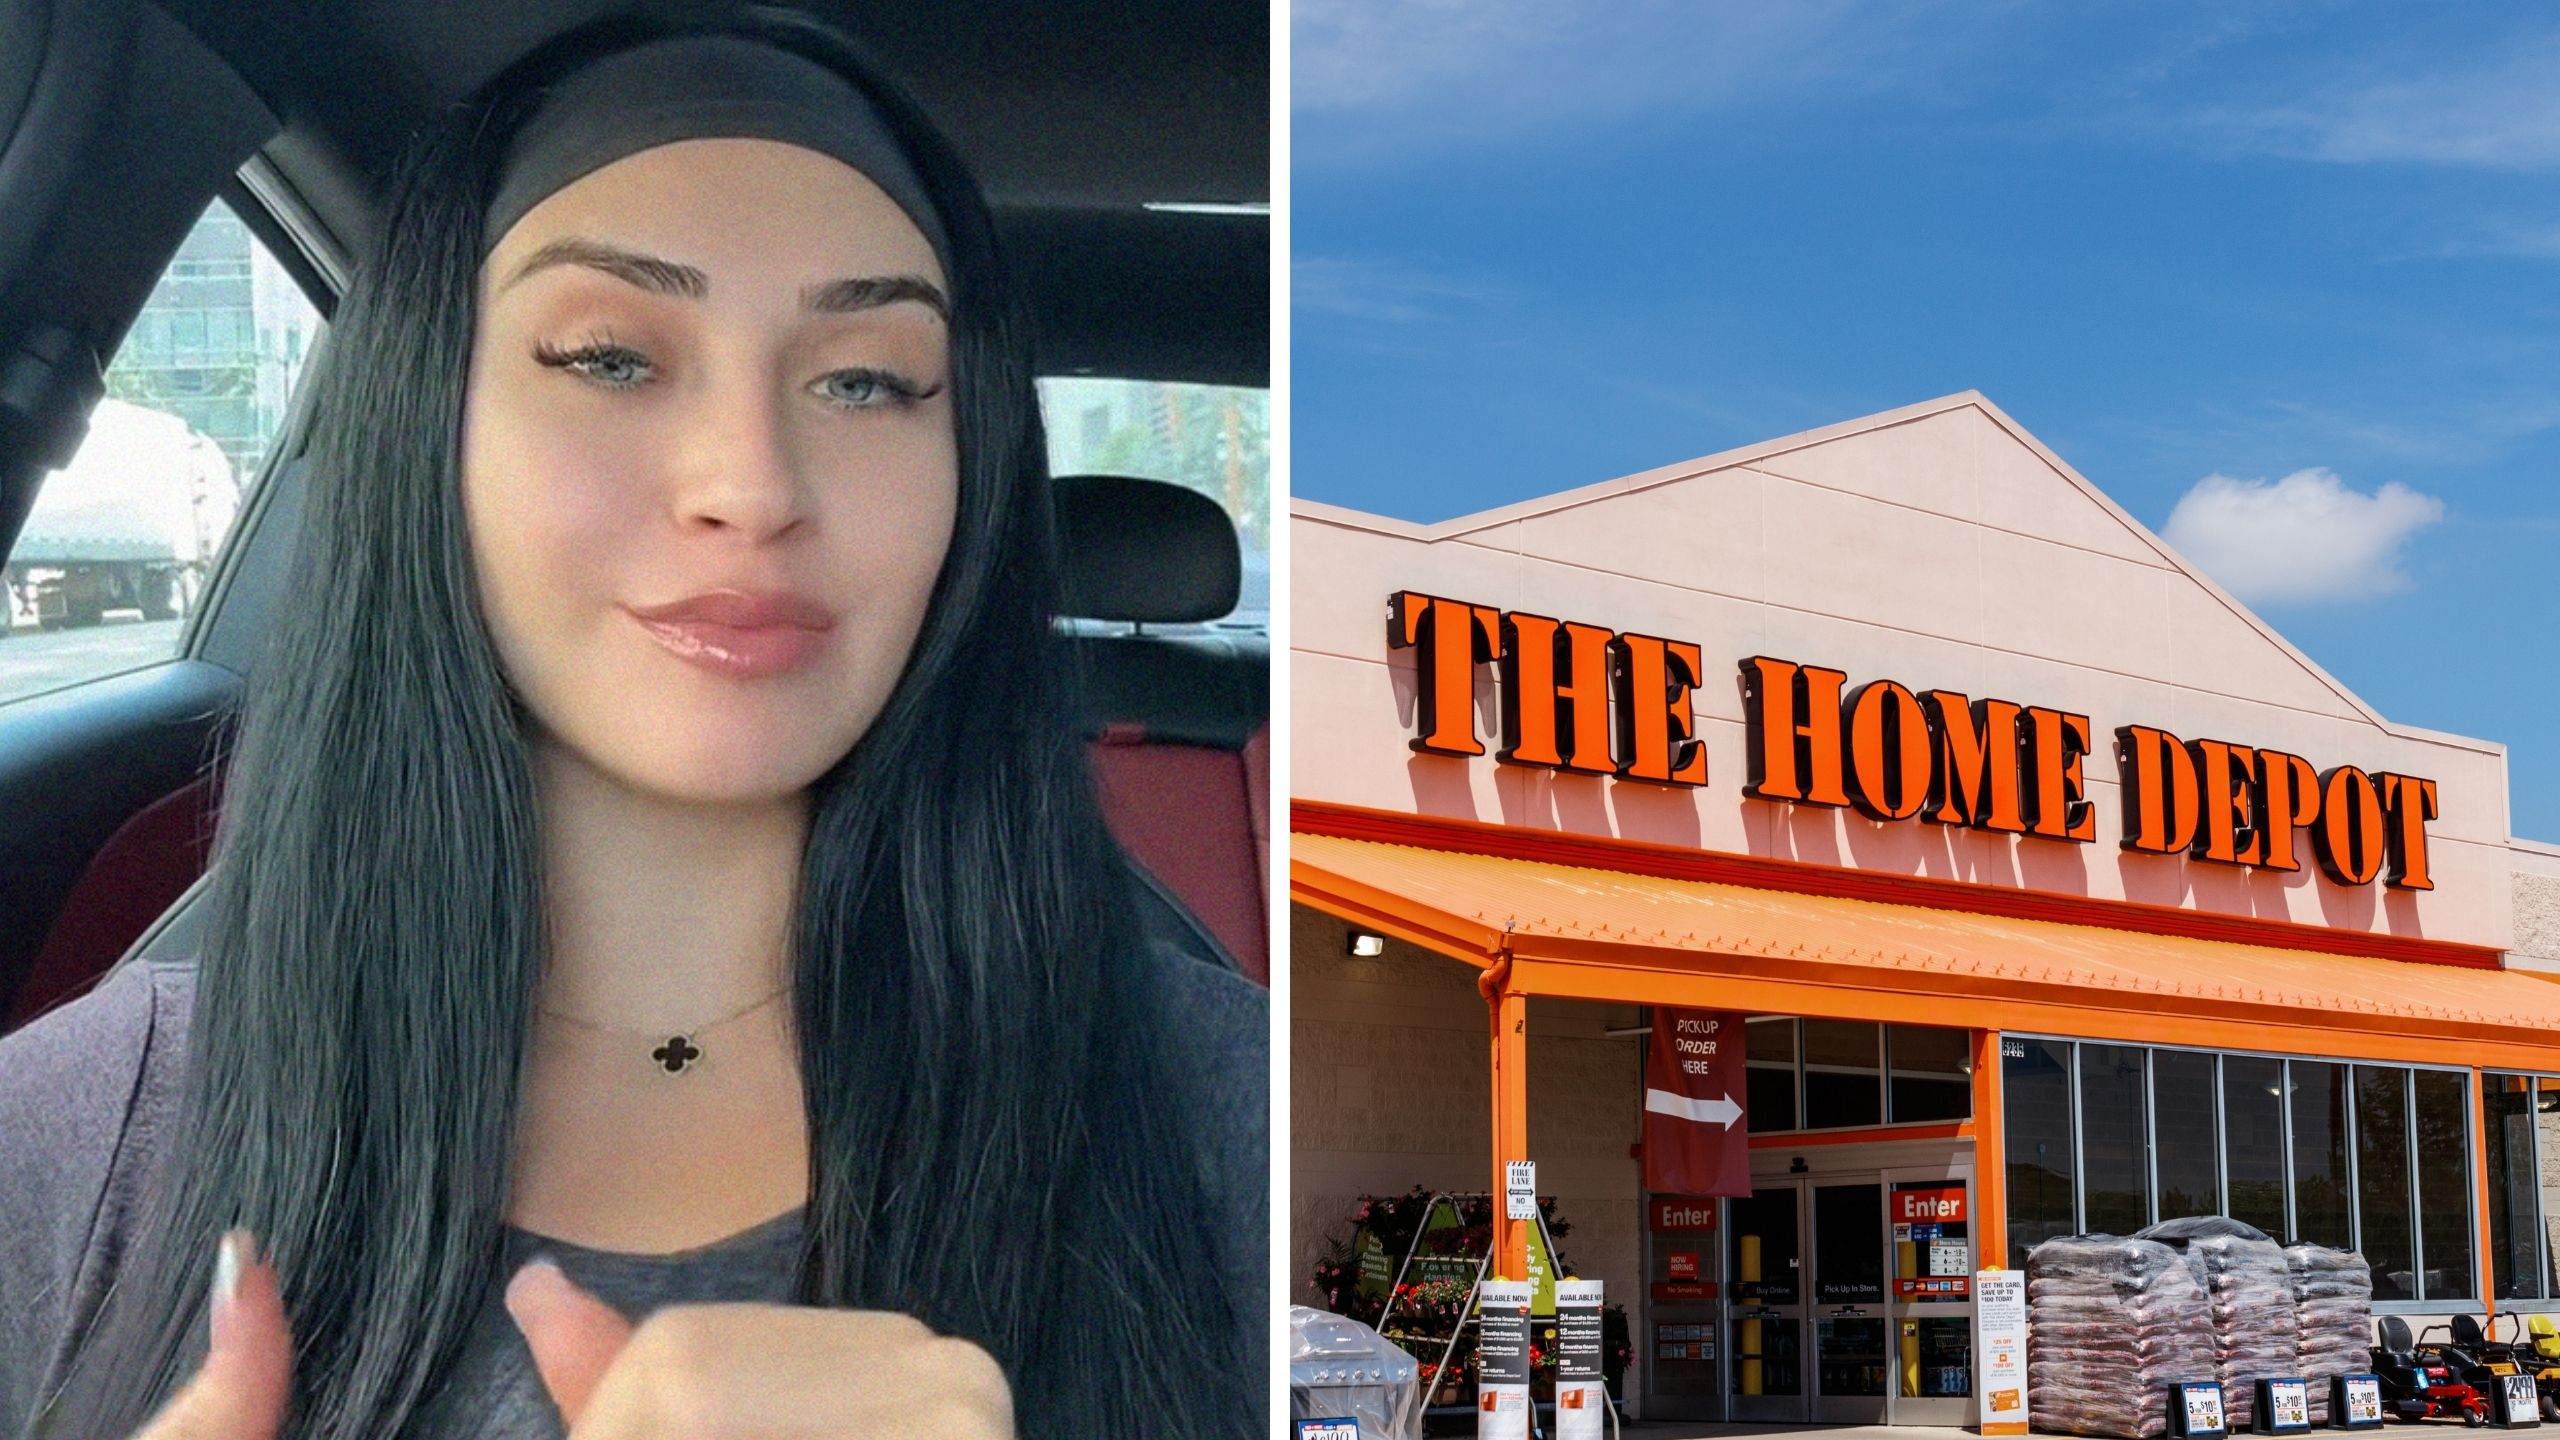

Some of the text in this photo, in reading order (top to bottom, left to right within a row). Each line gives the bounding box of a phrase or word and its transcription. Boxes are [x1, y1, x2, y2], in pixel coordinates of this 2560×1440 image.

[1387, 590, 2438, 891] THE HOME DEPOT
[1677, 1019, 1719, 1034] PICKUP
[1676, 1038, 1717, 1054] ORDER
[2003, 1042, 2024, 1057] 6235
[1681, 1059, 1708, 1074] HERE
[1511, 1168, 1530, 1176] FIRE
[1511, 1177, 1530, 1185] LANE
[1904, 1195, 1960, 1217] Enter
[1662, 1206, 1711, 1227] Enter
[1677, 1286, 1703, 1295] Smoking
[1756, 1287, 1768, 1295] Buy
[1824, 1285, 1839, 1293] Pick
[1840, 1285, 1850, 1293] Up
[1851, 1284, 1858, 1292] In
[1512, 1294, 1528, 1302] NOW
[1559, 1313, 1569, 1321] 24
[2275, 1396, 2281, 1408] 5
[2350, 1393, 2356, 1405] 5
[2188, 1402, 2194, 1413] 5
